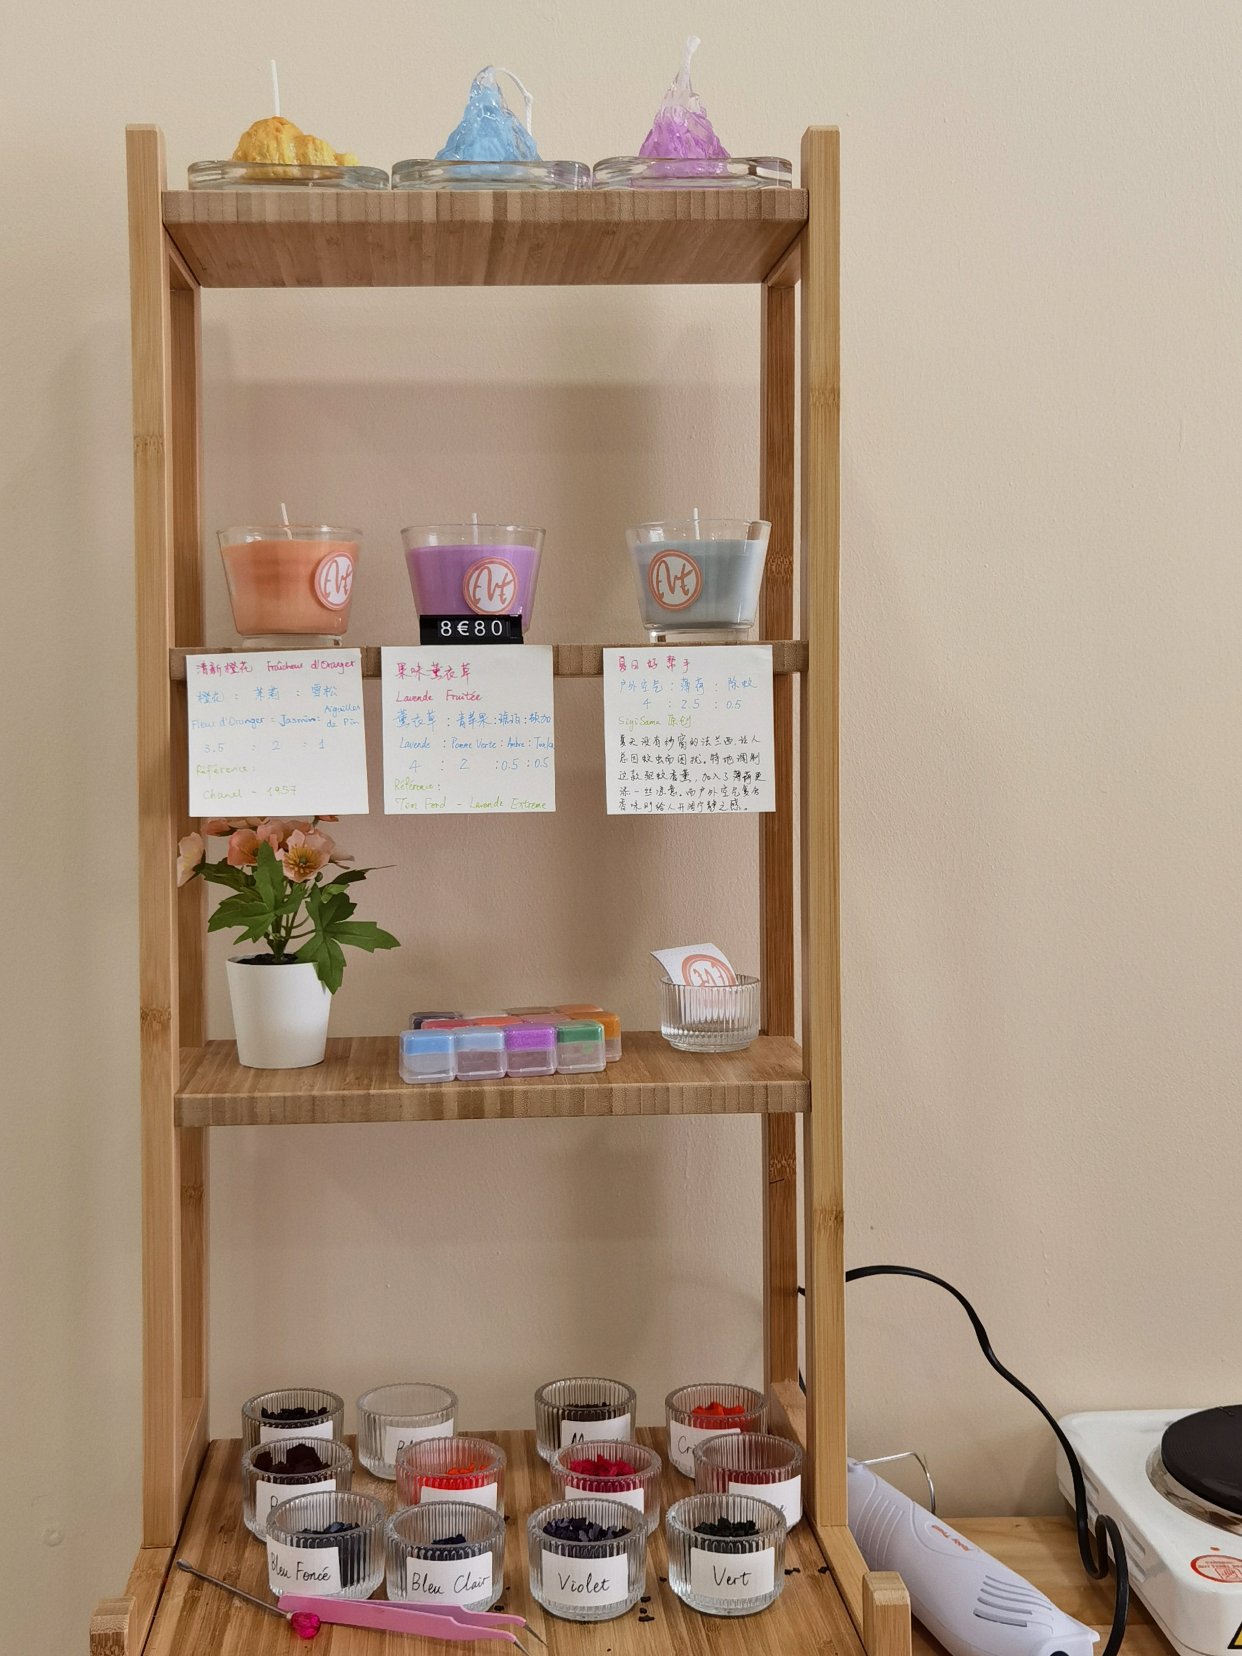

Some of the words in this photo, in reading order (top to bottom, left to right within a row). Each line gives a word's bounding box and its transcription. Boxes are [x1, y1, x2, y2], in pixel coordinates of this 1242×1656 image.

[440, 620, 503, 637] 8€80
[196, 660, 253, 677] 清新橙花
[254, 686, 280, 701] 茉莉
[310, 683, 338, 698] 雪松
[642, 698, 652, 710] 4
[726, 699, 742, 710] 0.5
[326, 719, 337, 728] de
[343, 718, 360, 727] Pin
[204, 742, 225, 753] 3.5
[271, 740, 280, 751] 2
[319, 738, 325, 750] 1
[451, 737, 473, 749] Pomme
[476, 738, 497, 749] Verte
[409, 759, 422, 773] 4
[460, 758, 470, 770] 2
[501, 757, 520, 770] 0.5
[534, 756, 550, 768] 0.5
[203, 788, 242, 800] Chanel
[395, 797, 418, 810] Tom
[271, 1554, 291, 1579] Bleu
[295, 1561, 331, 1581] Foncé
[712, 1565, 752, 1587] Vert
[411, 1573, 445, 1595] Bleu
[453, 1571, 490, 1591] Clair
[557, 1573, 611, 1593] Violet
